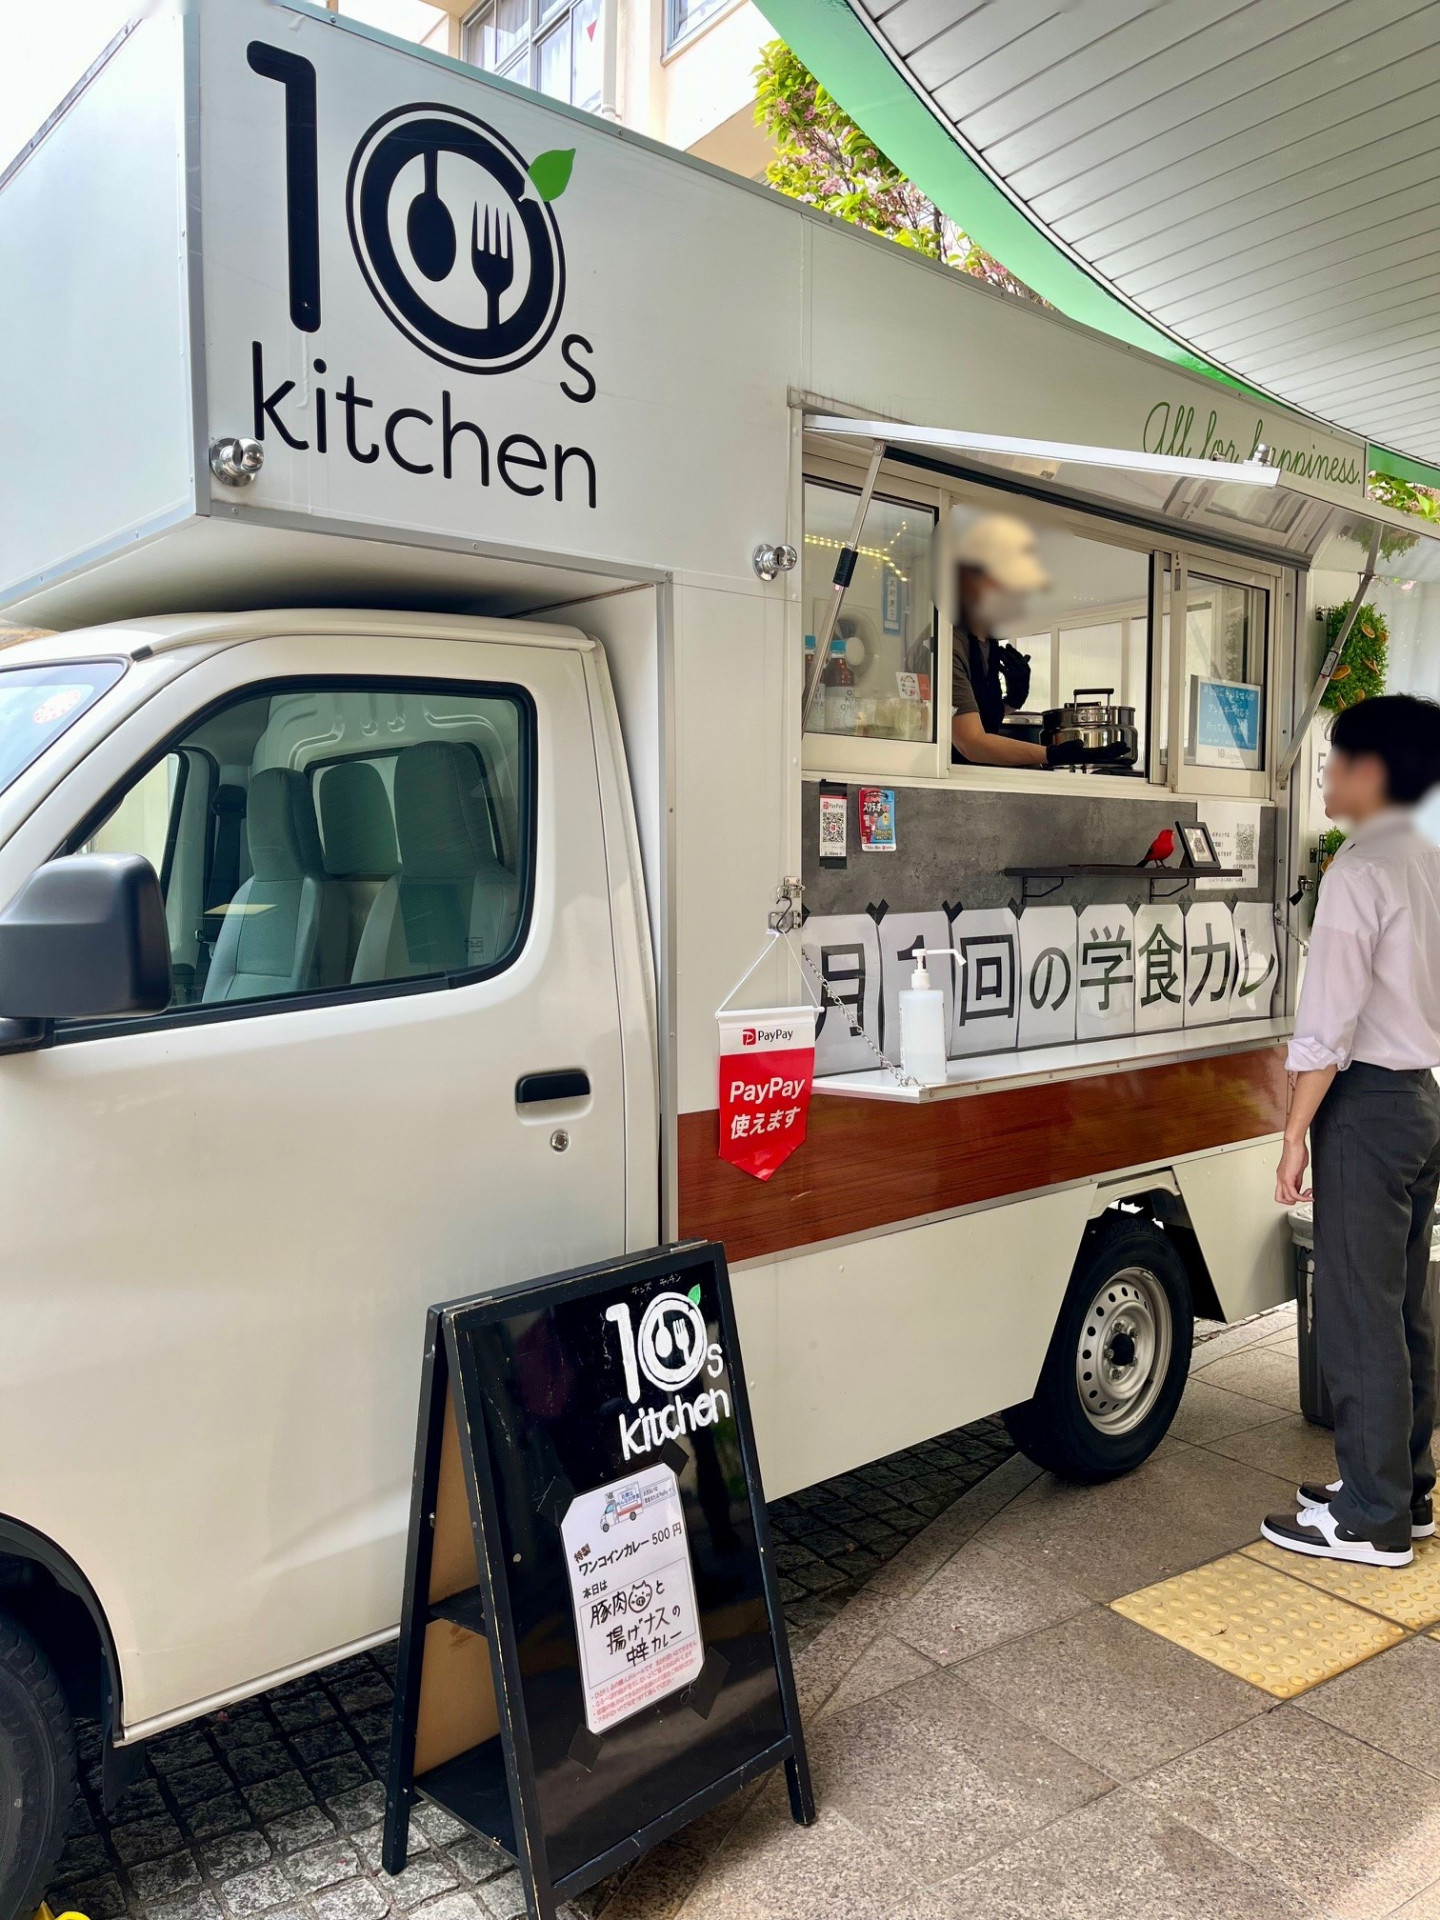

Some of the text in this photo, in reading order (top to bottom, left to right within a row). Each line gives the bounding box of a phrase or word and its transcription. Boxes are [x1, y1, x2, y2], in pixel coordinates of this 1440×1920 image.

[252, 340, 597, 508] kitchen
[1143, 402, 1192, 455] All
[757, 1029, 793, 1043] PayPay
[729, 1076, 806, 1104] PayPay
[730, 1106, 801, 1140] 使えます
[619, 1388, 730, 1461] kitchen
[578, 1522, 682, 1576] ワンコインカレー 500 円
[582, 1580, 608, 1599] 本日は
[590, 1580, 665, 1628] 豚肉 と
